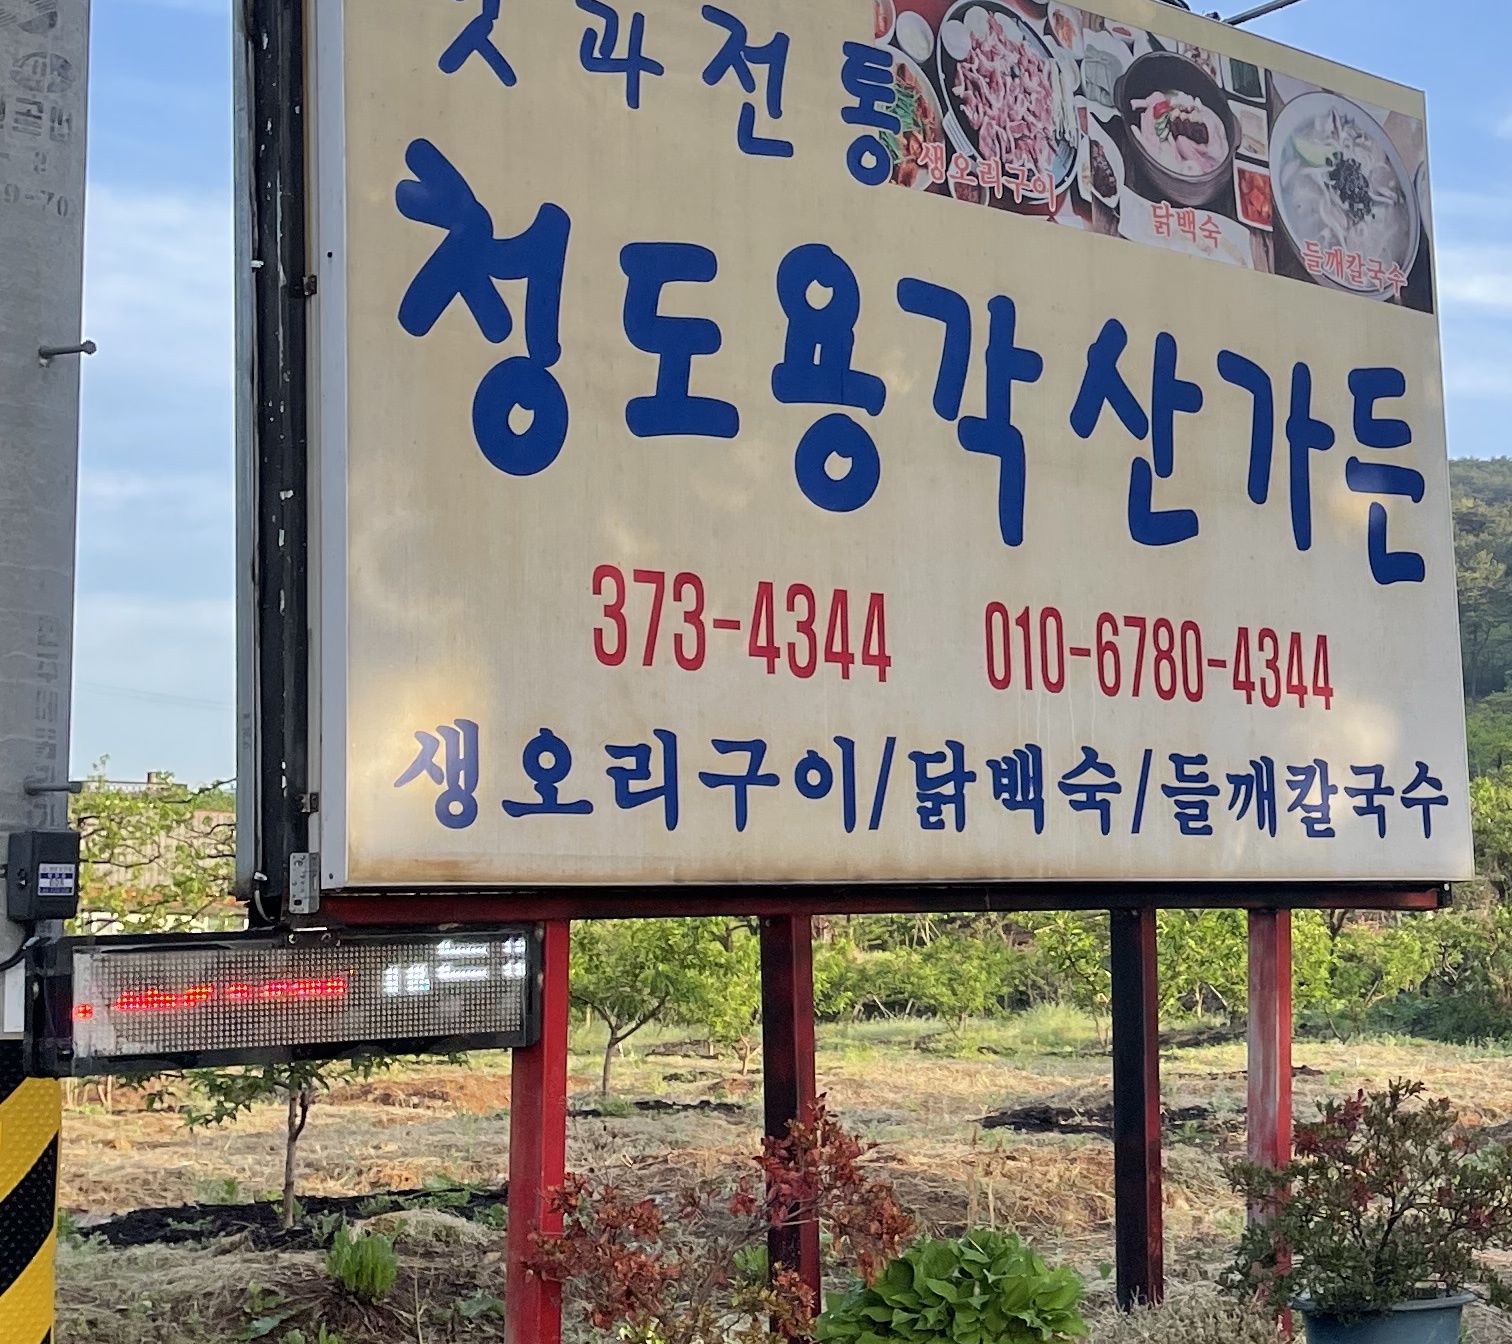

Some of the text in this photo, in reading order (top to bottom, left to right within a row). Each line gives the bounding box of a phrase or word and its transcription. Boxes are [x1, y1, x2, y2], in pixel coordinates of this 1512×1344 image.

[919, 142, 1057, 212] 생오리구이
[1150, 200, 1223, 250] 닭백숙
[1301, 239, 1409, 296] 들깨칼국수
[591, 563, 1335, 711] 373-4344 010-6780-4344
